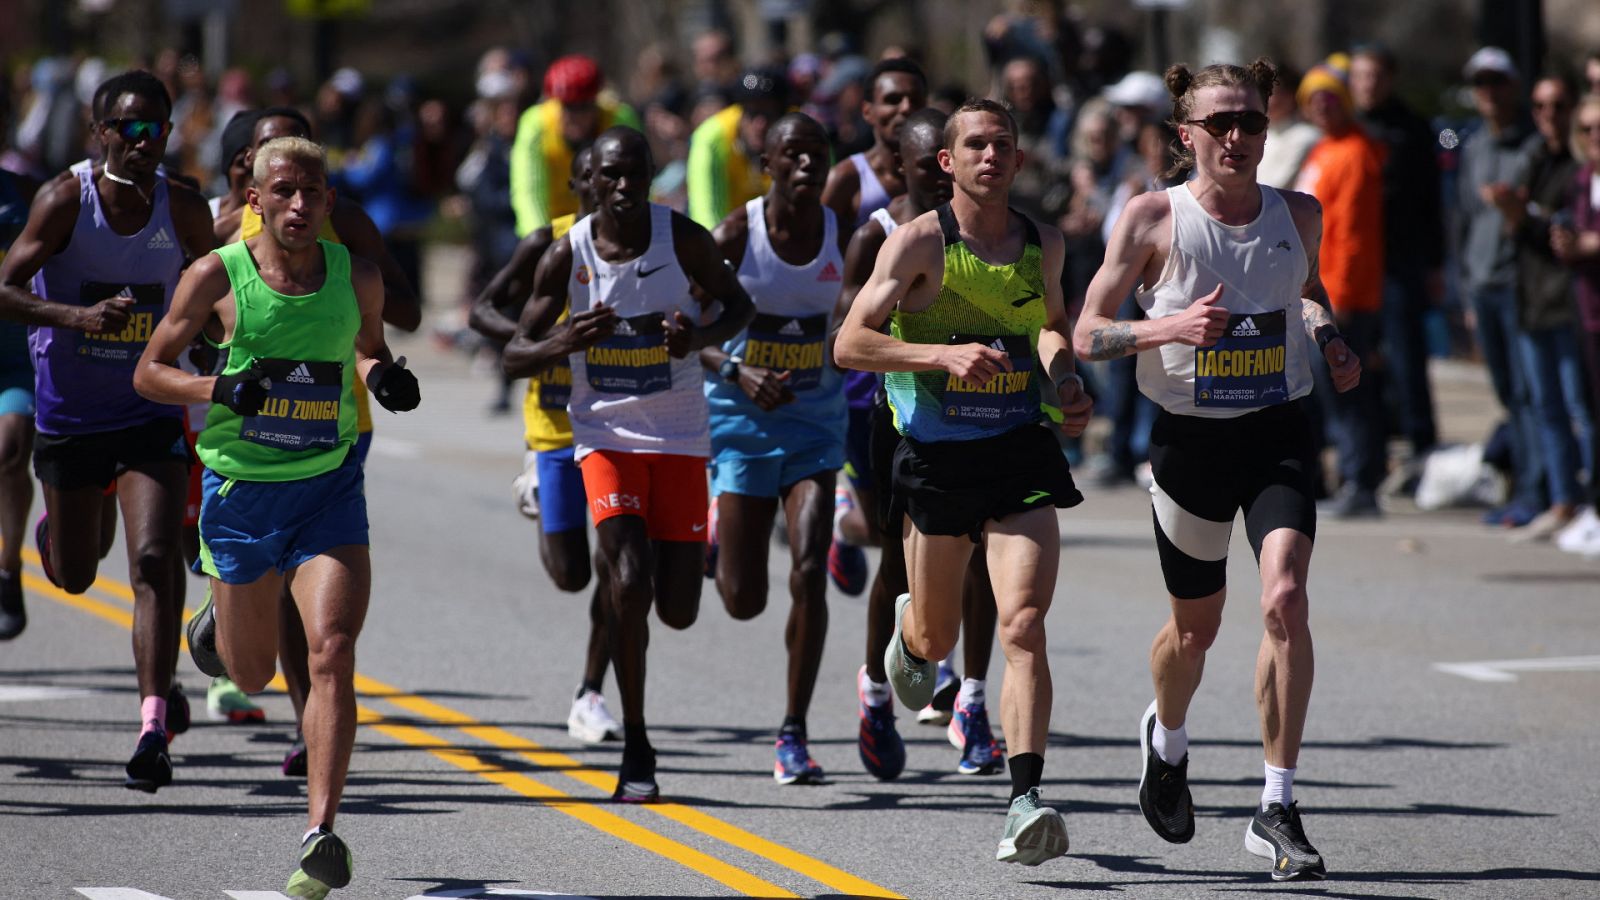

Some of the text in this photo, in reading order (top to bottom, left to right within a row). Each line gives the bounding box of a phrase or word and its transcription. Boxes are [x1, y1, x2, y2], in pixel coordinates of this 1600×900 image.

[745, 339, 824, 370] BENSON
[1197, 345, 1285, 377] IACOFANO
[286, 375, 315, 384] adidas
[291, 400, 339, 420] ZUNIGA
[961, 411, 1000, 419] MARATHON
[259, 435, 300, 445] MARATHON
[274, 432, 300, 440] BOSTON
[593, 493, 641, 513] INEOS
